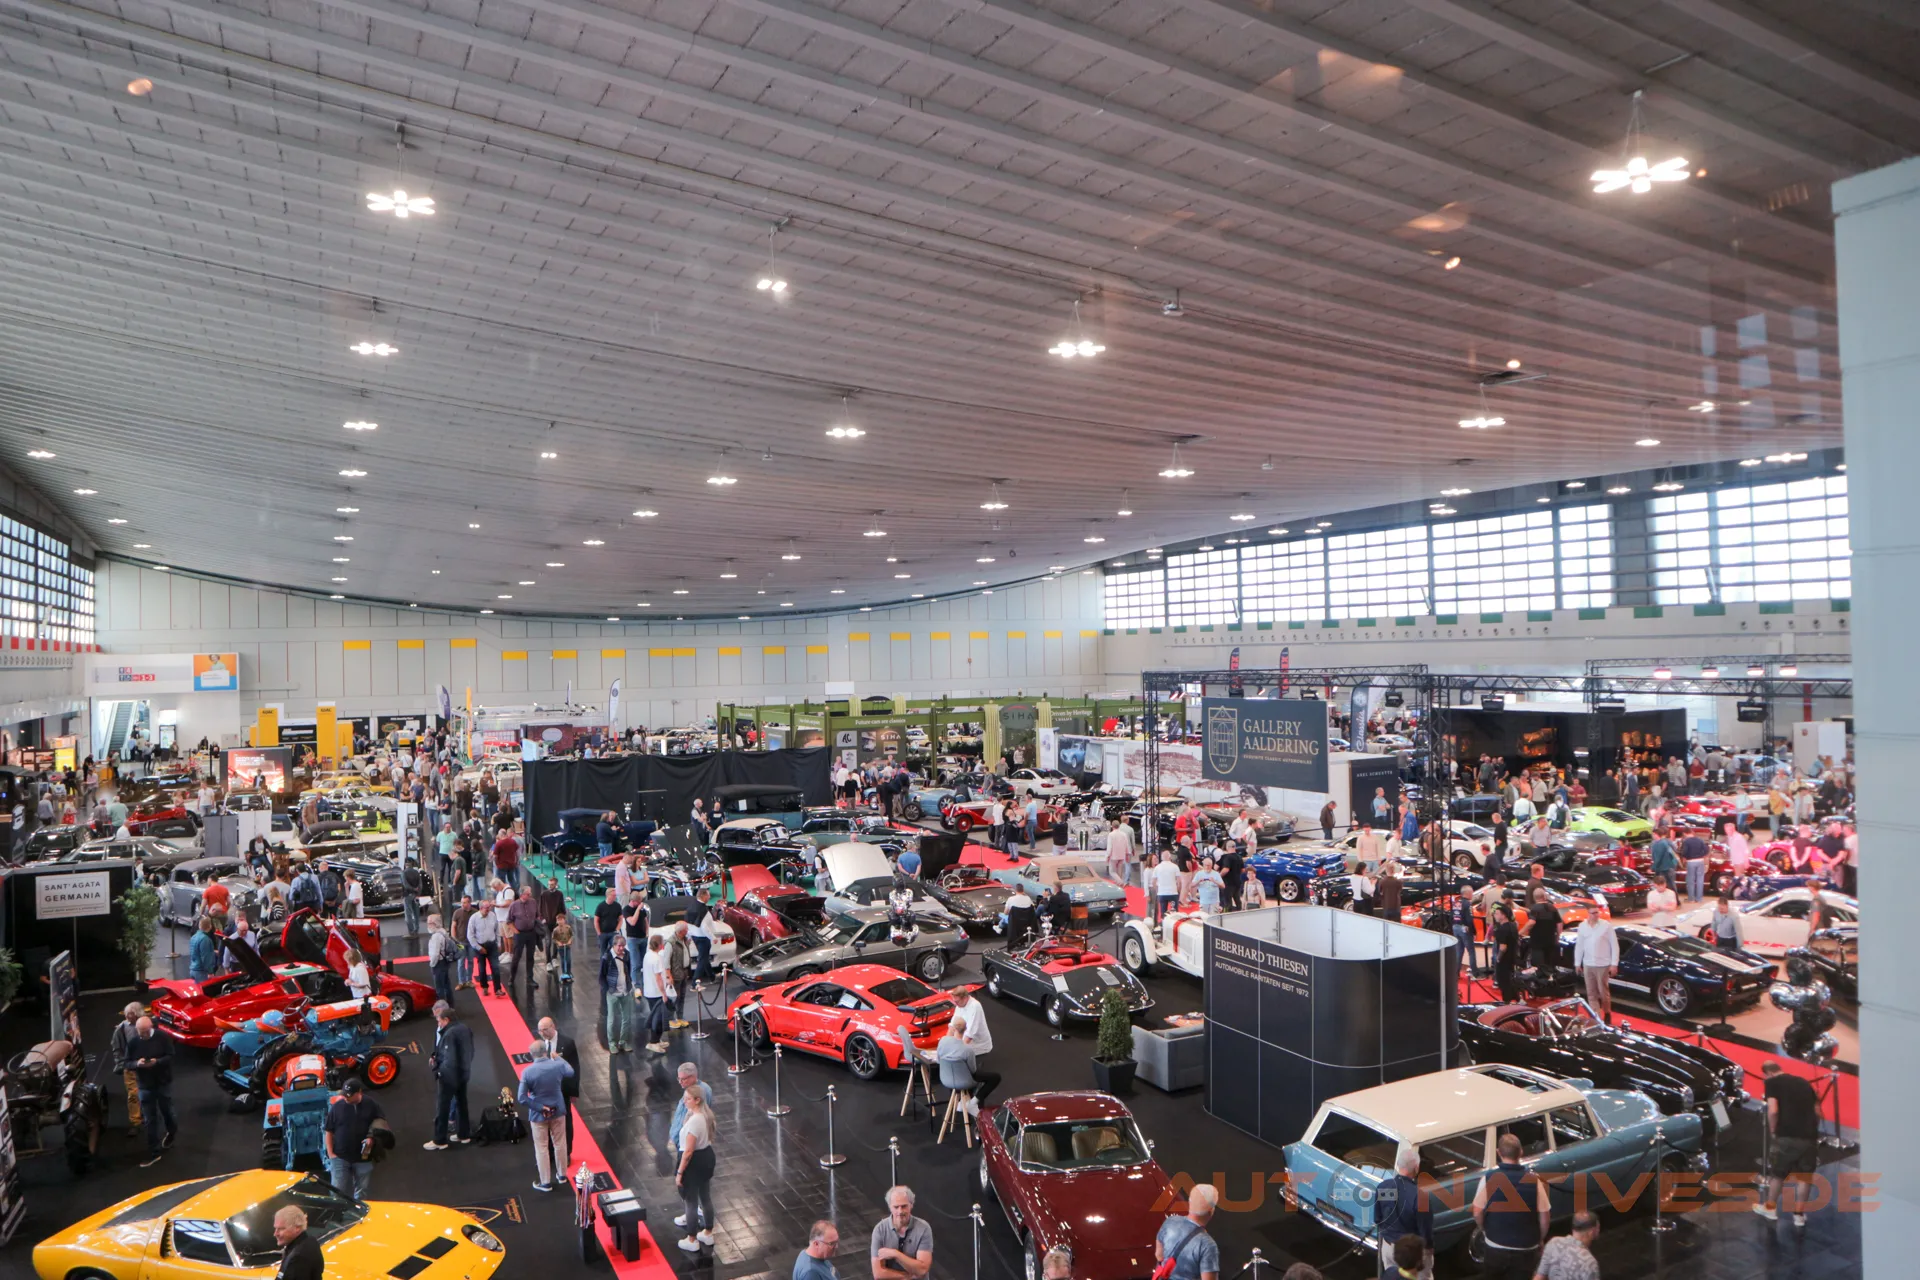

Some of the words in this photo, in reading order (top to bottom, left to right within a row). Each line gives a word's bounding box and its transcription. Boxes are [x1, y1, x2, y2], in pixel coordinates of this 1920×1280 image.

[1243, 718, 1302, 736] GALLERY
[1243, 735, 1320, 756] AALDERING
[44, 892, 101, 903] GERMANIA
[1214, 938, 1265, 963] EBERHARD
[1266, 953, 1309, 977] THIESEN
[1214, 961, 1250, 978] AUTOMOBILE
[1250, 971, 1281, 988] RARITÄTEN
[1281, 982, 1295, 992] SEIT
[1295, 987, 1309, 998] 1972
